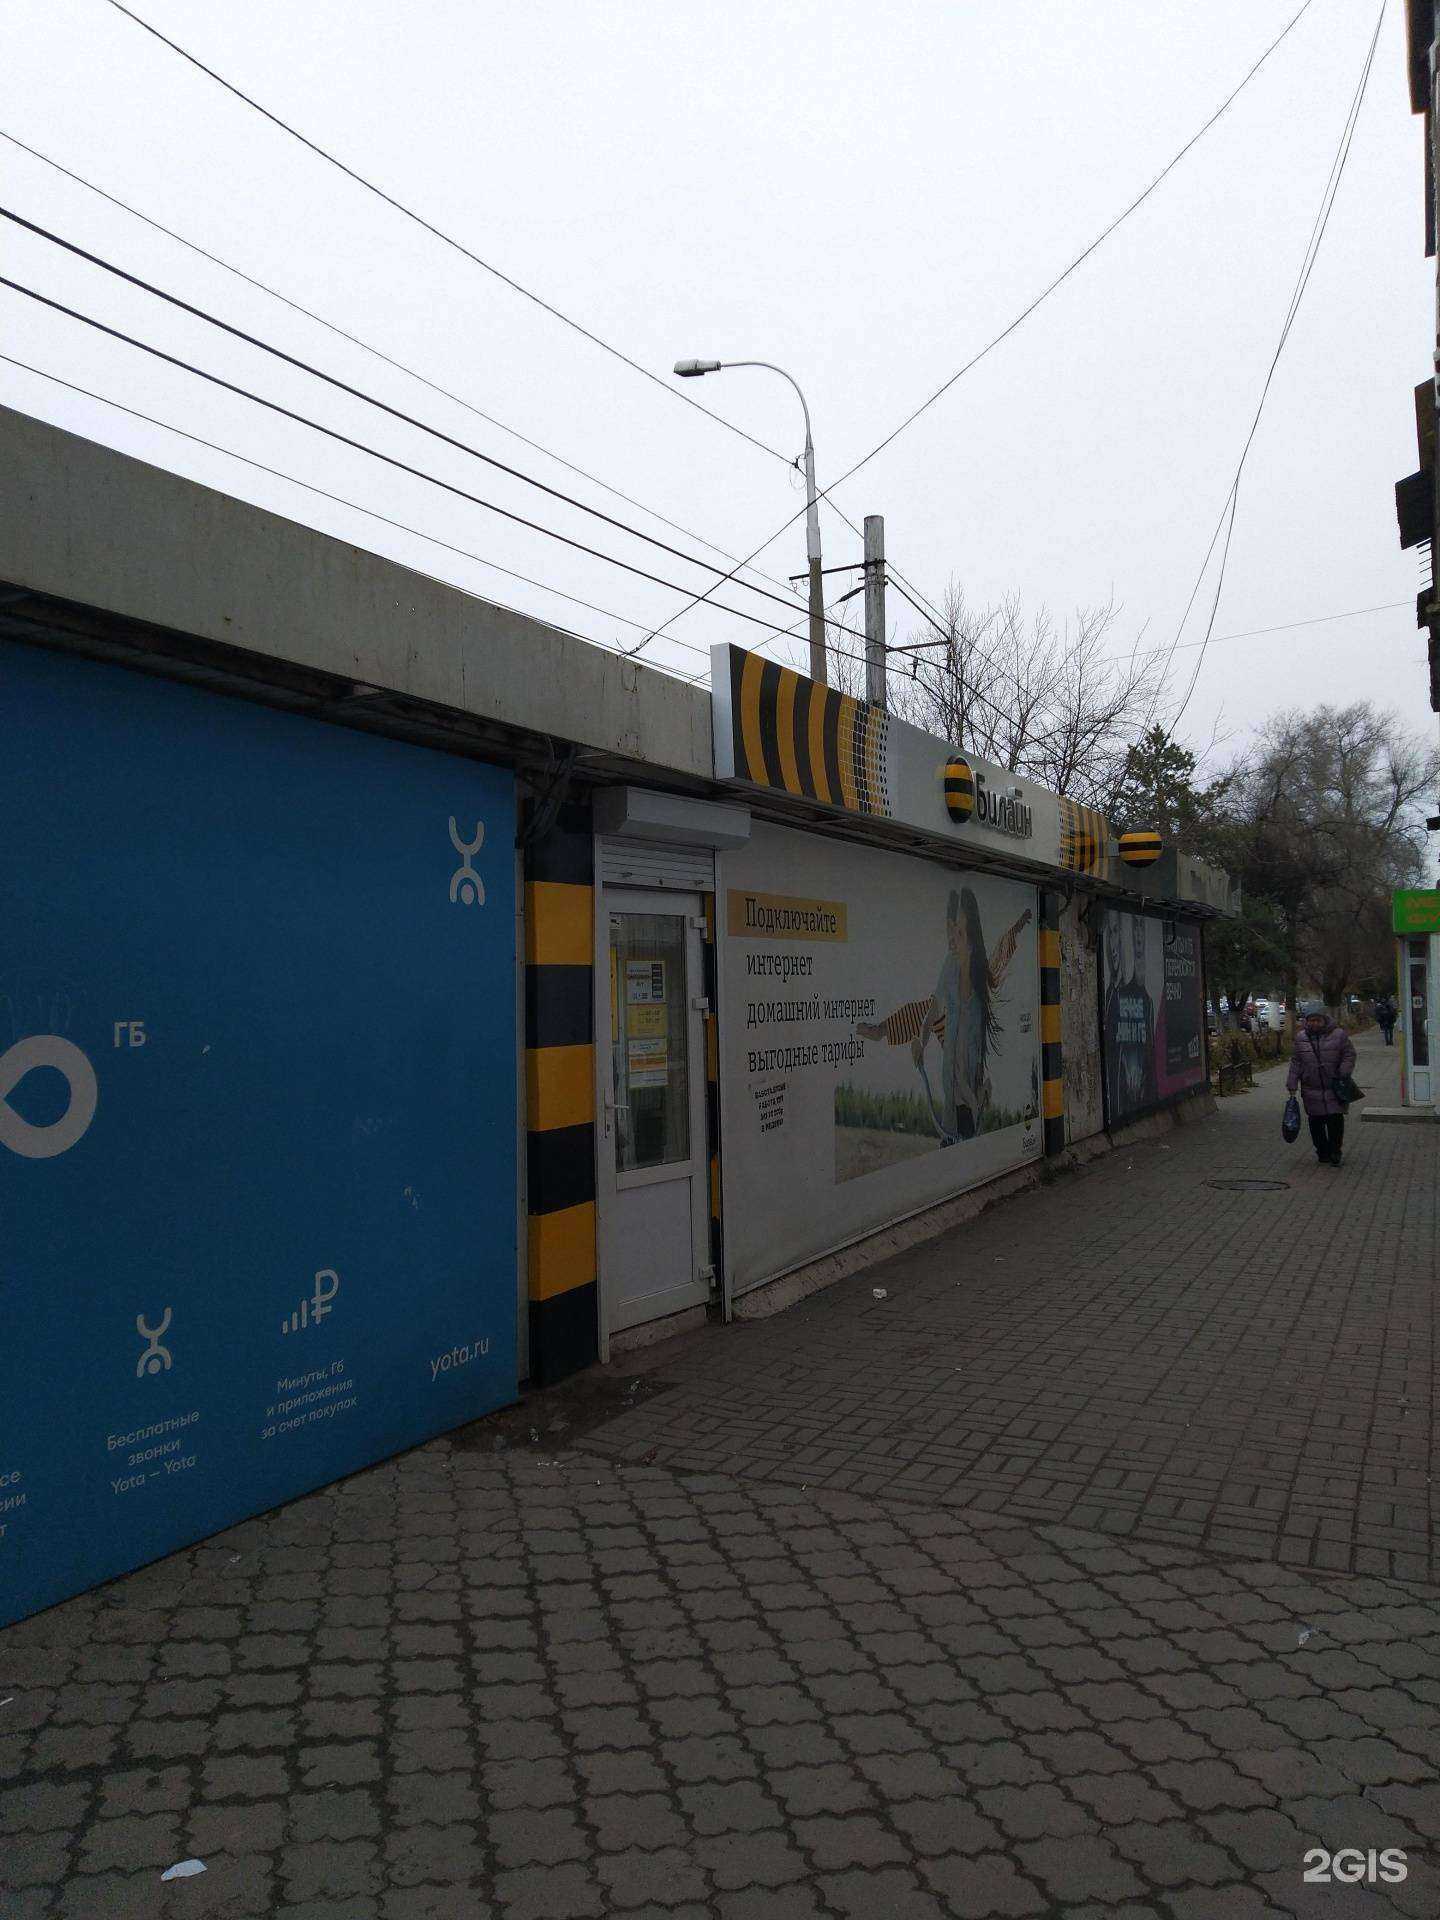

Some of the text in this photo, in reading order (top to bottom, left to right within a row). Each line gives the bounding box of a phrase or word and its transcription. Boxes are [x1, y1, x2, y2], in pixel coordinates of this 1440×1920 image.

[976, 773, 1033, 838] Билайн
[745, 897, 837, 933] Подключайте
[747, 954, 813, 983] интернет
[747, 993, 876, 1029] домашний интернет
[113, 1021, 146, 1048] ГБ
[748, 1033, 865, 1073] выгодные тарифы
[277, 1359, 344, 1392] Минуты, Гб
[430, 1337, 489, 1382] yota.ru
[265, 1379, 353, 1416] и приложения
[107, 1410, 200, 1451] Бесплатные
[261, 1396, 357, 1440] за счет покупок
[128, 1440, 181, 1465] звонки
[111, 1474, 145, 1494] Yota
[164, 1456, 195, 1474] Yota
